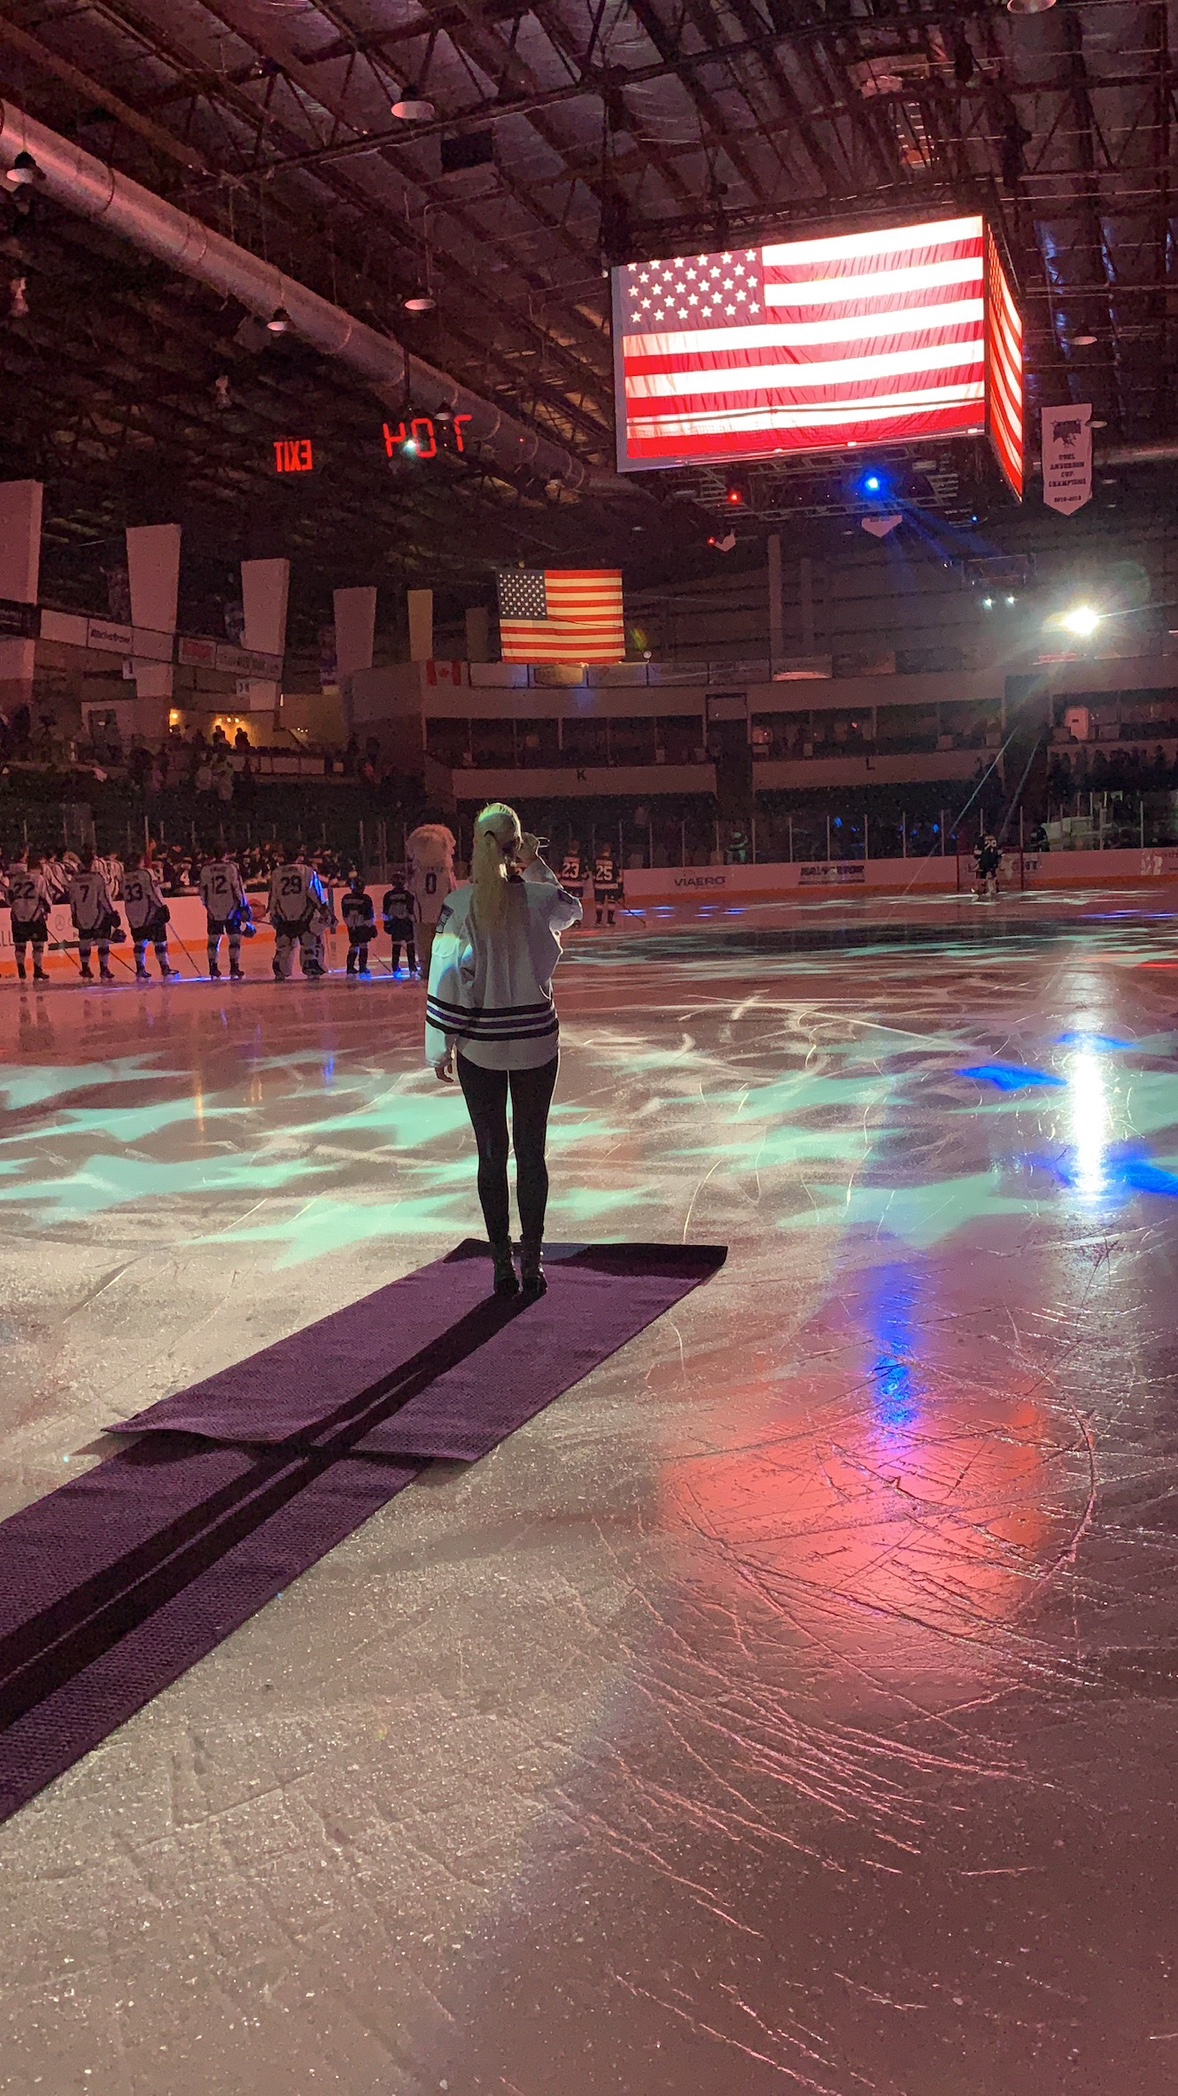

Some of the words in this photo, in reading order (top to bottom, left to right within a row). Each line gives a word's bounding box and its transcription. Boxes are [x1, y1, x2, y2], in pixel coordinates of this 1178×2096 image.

[1048, 478, 1086, 487] CHAMPIONS
[866, 757, 876, 770] L
[576, 769, 587, 782] K
[563, 862, 580, 879] 23
[596, 865, 613, 881] 25
[14, 881, 35, 899] 22
[211, 875, 228, 895] 12
[280, 875, 302, 896] 29
[673, 876, 726, 887] VIAERO
[79, 884, 89, 902] 7
[125, 882, 143, 903] 33
